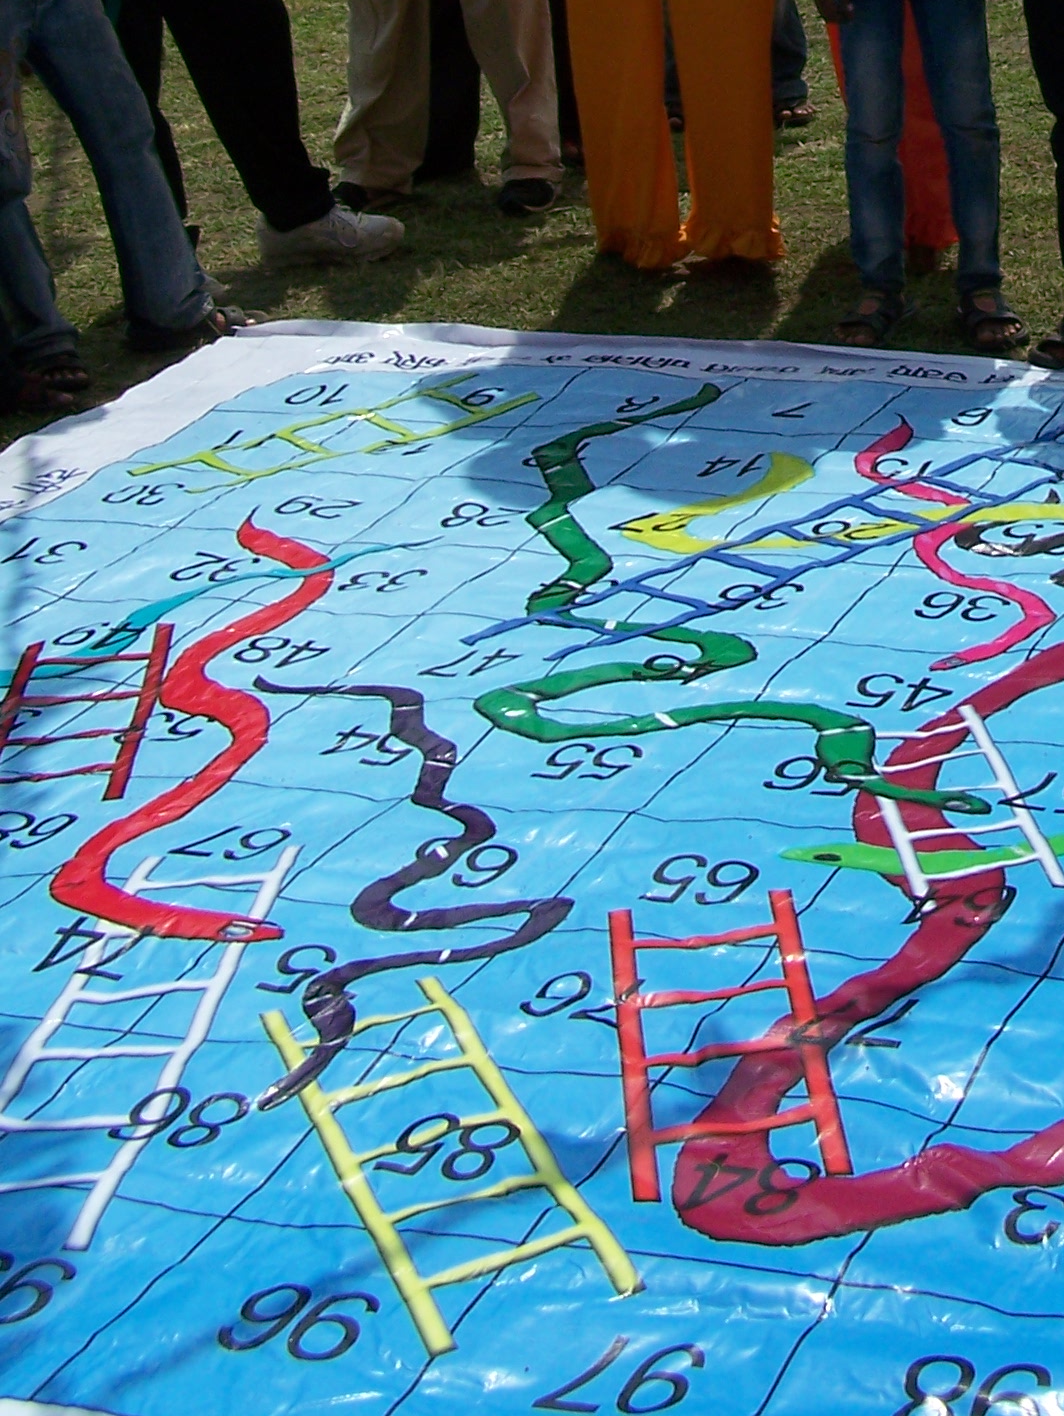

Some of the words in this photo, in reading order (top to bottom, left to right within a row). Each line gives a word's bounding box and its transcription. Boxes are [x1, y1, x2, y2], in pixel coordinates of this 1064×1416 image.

[285, 384, 350, 407] 10
[460, 387, 504, 407] 9
[771, 401, 817, 418] 7
[951, 407, 994, 426] 6
[696, 453, 766, 478] 14
[102, 483, 185, 505] 30
[273, 495, 364, 520] 29
[440, 501, 528, 528] 28
[1, 536, 89, 565] 31
[169, 550, 260, 583] 32
[338, 569, 429, 594] 33
[707, 584, 804, 611] 35
[914, 591, 1011, 621] 36
[52, 621, 148, 650] 49
[233, 635, 332, 670] 48
[417, 647, 525, 678] 47
[846, 673, 954, 713] 45
[321, 723, 413, 766] 54
[530, 742, 644, 780] 55
[168, 825, 293, 861] 67
[638, 853, 761, 906] 65
[34, 917, 154, 981] 74
[108, 1087, 254, 1149] 86
[373, 1113, 522, 1181] 85
[679, 1153, 820, 1216] 84
[0, 1251, 77, 1325] 9
[218, 1283, 381, 1361] 96
[532, 1335, 706, 1415] 97
